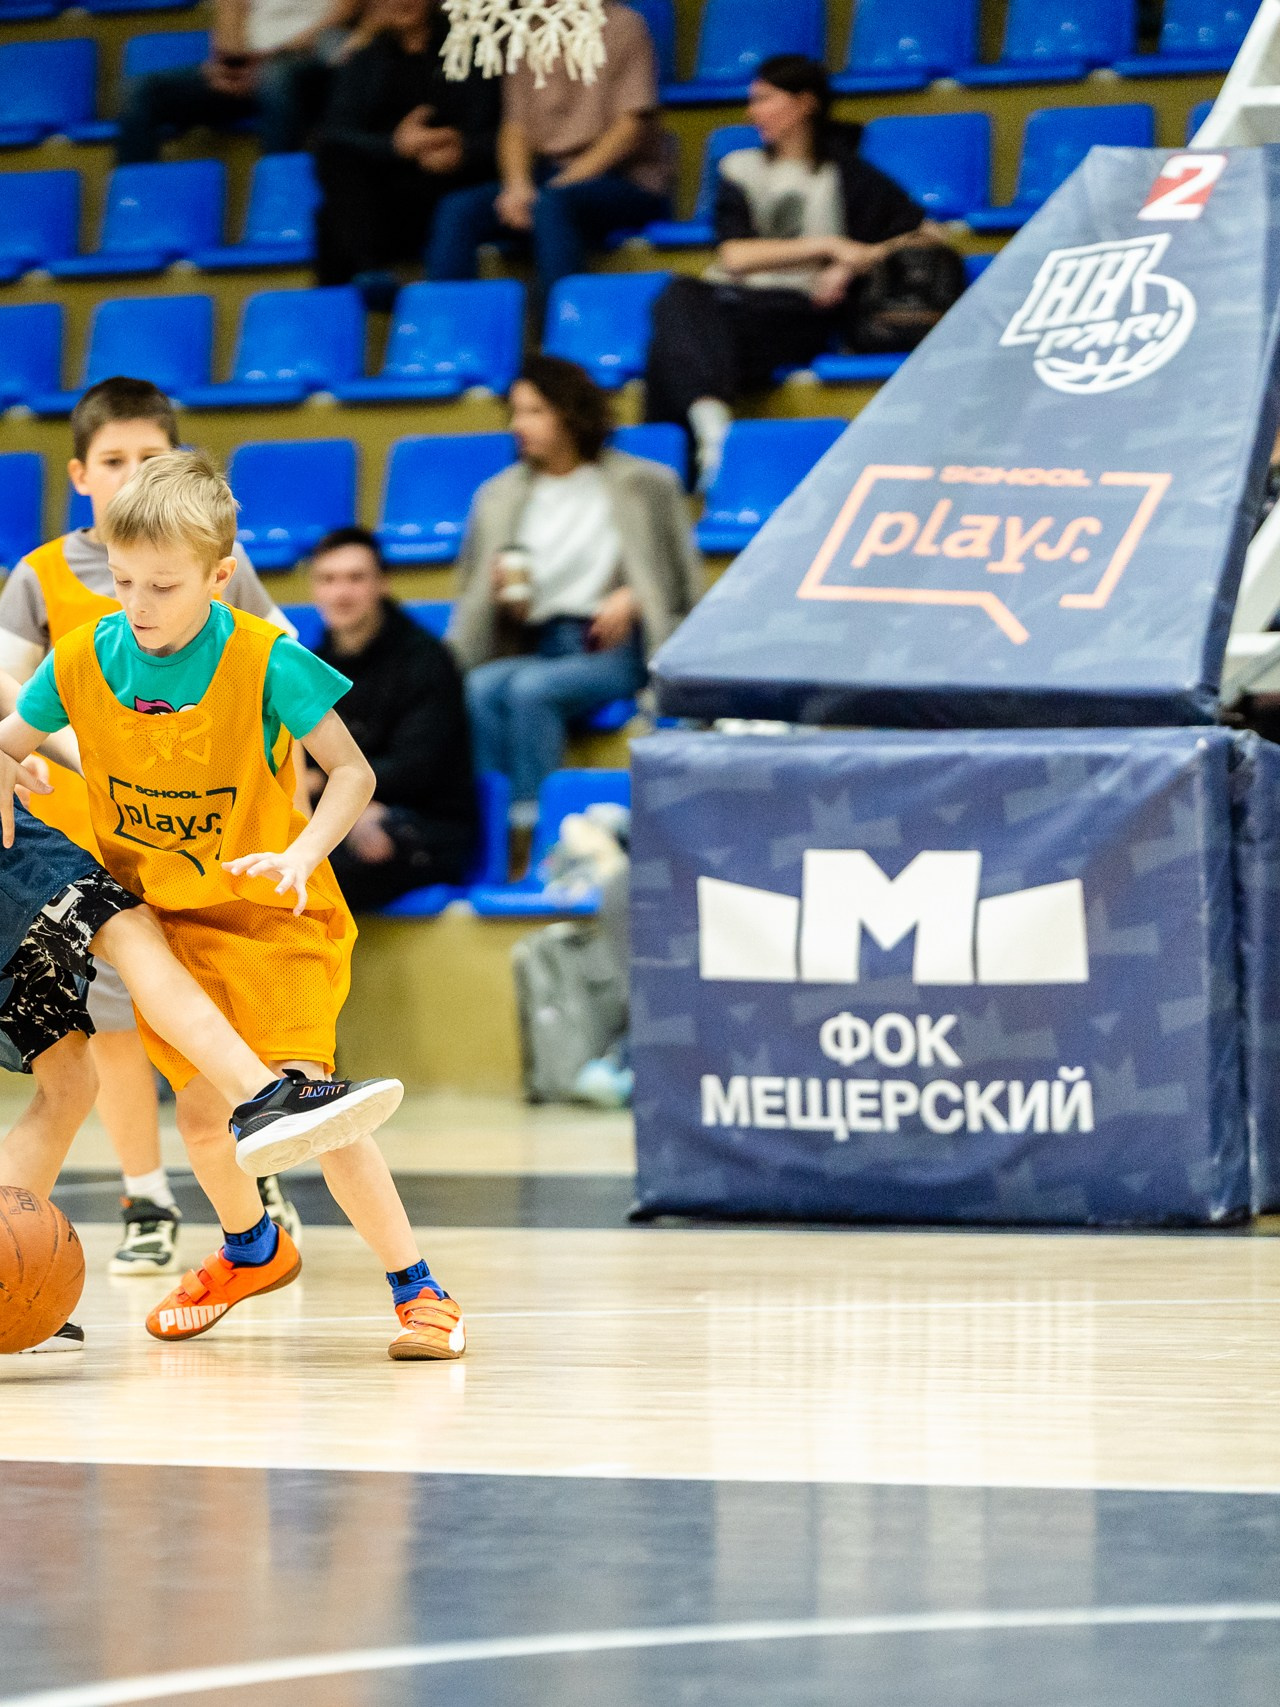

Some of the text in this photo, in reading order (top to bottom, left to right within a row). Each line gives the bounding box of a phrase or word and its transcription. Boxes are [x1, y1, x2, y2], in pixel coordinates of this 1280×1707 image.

[1137, 155, 1228, 220] 2
[1034, 310, 1179, 357] PARI
[939, 465, 1093, 487] SCHOOL
[135, 784, 202, 799] SCHOOL
[819, 1011, 963, 1066] ФОК
[700, 1066, 1095, 1142] МЕЩЕРСКИЙ
